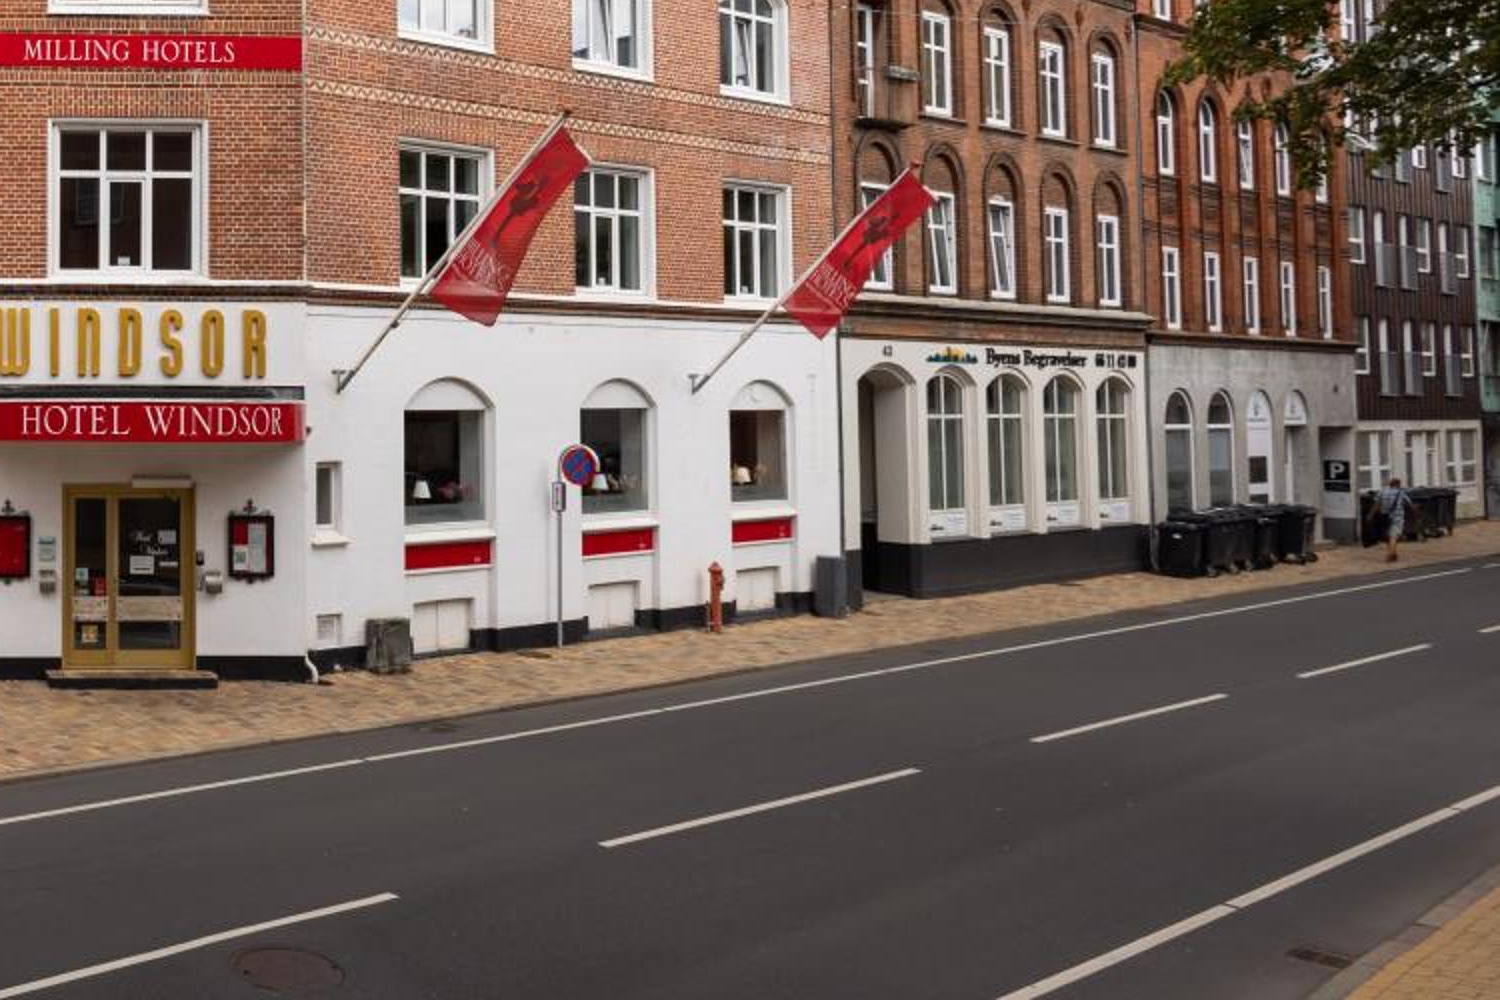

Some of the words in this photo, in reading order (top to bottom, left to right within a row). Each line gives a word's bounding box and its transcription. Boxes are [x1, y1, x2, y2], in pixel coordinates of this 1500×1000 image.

[24, 39, 130, 61] MILLING
[142, 40, 236, 63] HOTELS
[21, 405, 131, 436] HOTEL
[144, 406, 282, 436] WINDSOR
[1330, 462, 1345, 479] P
